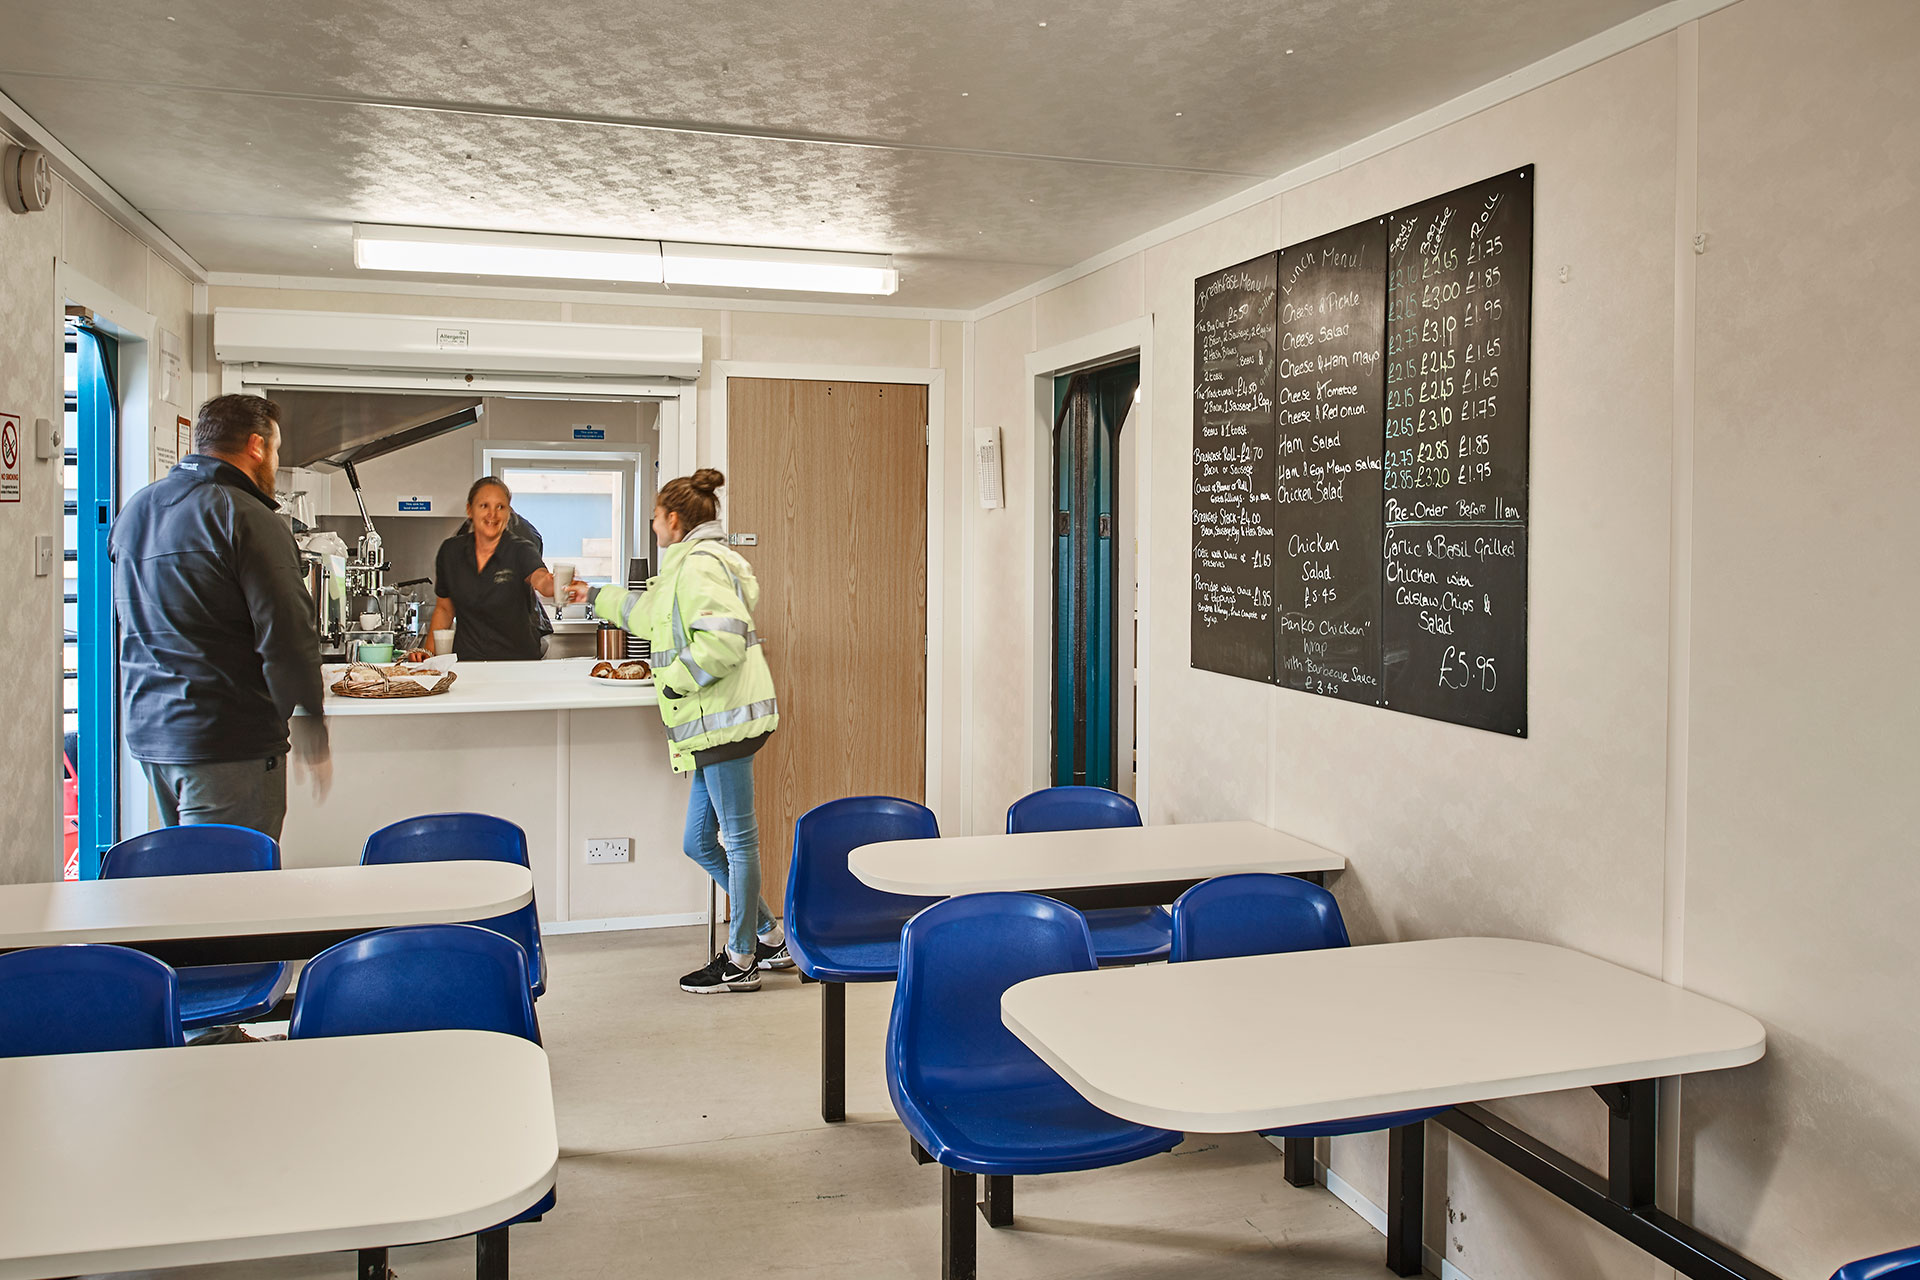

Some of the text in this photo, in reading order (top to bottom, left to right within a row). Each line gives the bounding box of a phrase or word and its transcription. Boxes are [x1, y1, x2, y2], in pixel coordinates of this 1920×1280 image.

[1282, 244, 1365, 295] Lunch Menu!
[1421, 248, 1458, 280] £2.65
[1467, 236, 1503, 265] £1.75
[1197, 272, 1268, 312] Breakfast Menu!
[1421, 281, 1461, 310] £3.00
[1465, 266, 1501, 294] £1.85
[1282, 303, 1314, 325] Cheese
[1325, 290, 1360, 313] Pickle
[1196, 319, 1207, 334] The
[1206, 321, 1216, 337] Big
[1216, 319, 1225, 330] One
[1282, 323, 1350, 352] Cheese Salad
[1388, 326, 1419, 355] £2.75
[1464, 299, 1502, 327] £1.95
[1280, 358, 1314, 379] Cheese
[1317, 354, 1324, 374] &
[1323, 354, 1349, 372] Ham
[1388, 358, 1417, 383] £2.15
[1465, 337, 1501, 363] £1.65
[1194, 383, 1205, 400] The
[1280, 387, 1311, 405] Cheese
[1387, 366, 1499, 410] £2.15 £2.45 £1.65
[1280, 409, 1311, 426] Cheese
[1322, 403, 1339, 420] Red
[1385, 396, 1497, 439] £2.65 £3.10 £1.75
[1193, 447, 1222, 465] Breakfast
[1222, 446, 1237, 462] Roll
[1278, 430, 1341, 456] Ham Salad
[1384, 448, 1414, 470] £2.75
[1459, 434, 1490, 458] £1.85
[1278, 463, 1300, 484] Ham
[1309, 463, 1325, 484] Egg
[1326, 458, 1352, 483] Mayo
[1383, 461, 1492, 490] £2.85 £3.20 £1.95
[1277, 480, 1344, 504] Chicken Salad
[1455, 499, 1487, 519] Before
[1288, 532, 1340, 558] Chicken
[1383, 528, 1422, 562] Garlic
[1433, 534, 1471, 559] Basil
[1474, 537, 1516, 562] Grilled
[1386, 561, 1474, 588] Chicken with
[1304, 586, 1337, 609] £5.45
[1442, 591, 1474, 615] Chips
[1483, 593, 1492, 616] &
[1418, 610, 1454, 635] Salad
[1304, 657, 1350, 683] Barbecue
[1350, 666, 1378, 686] Sauce
[1438, 645, 1497, 693] £5.95
[1304, 675, 1339, 694] £3.45
